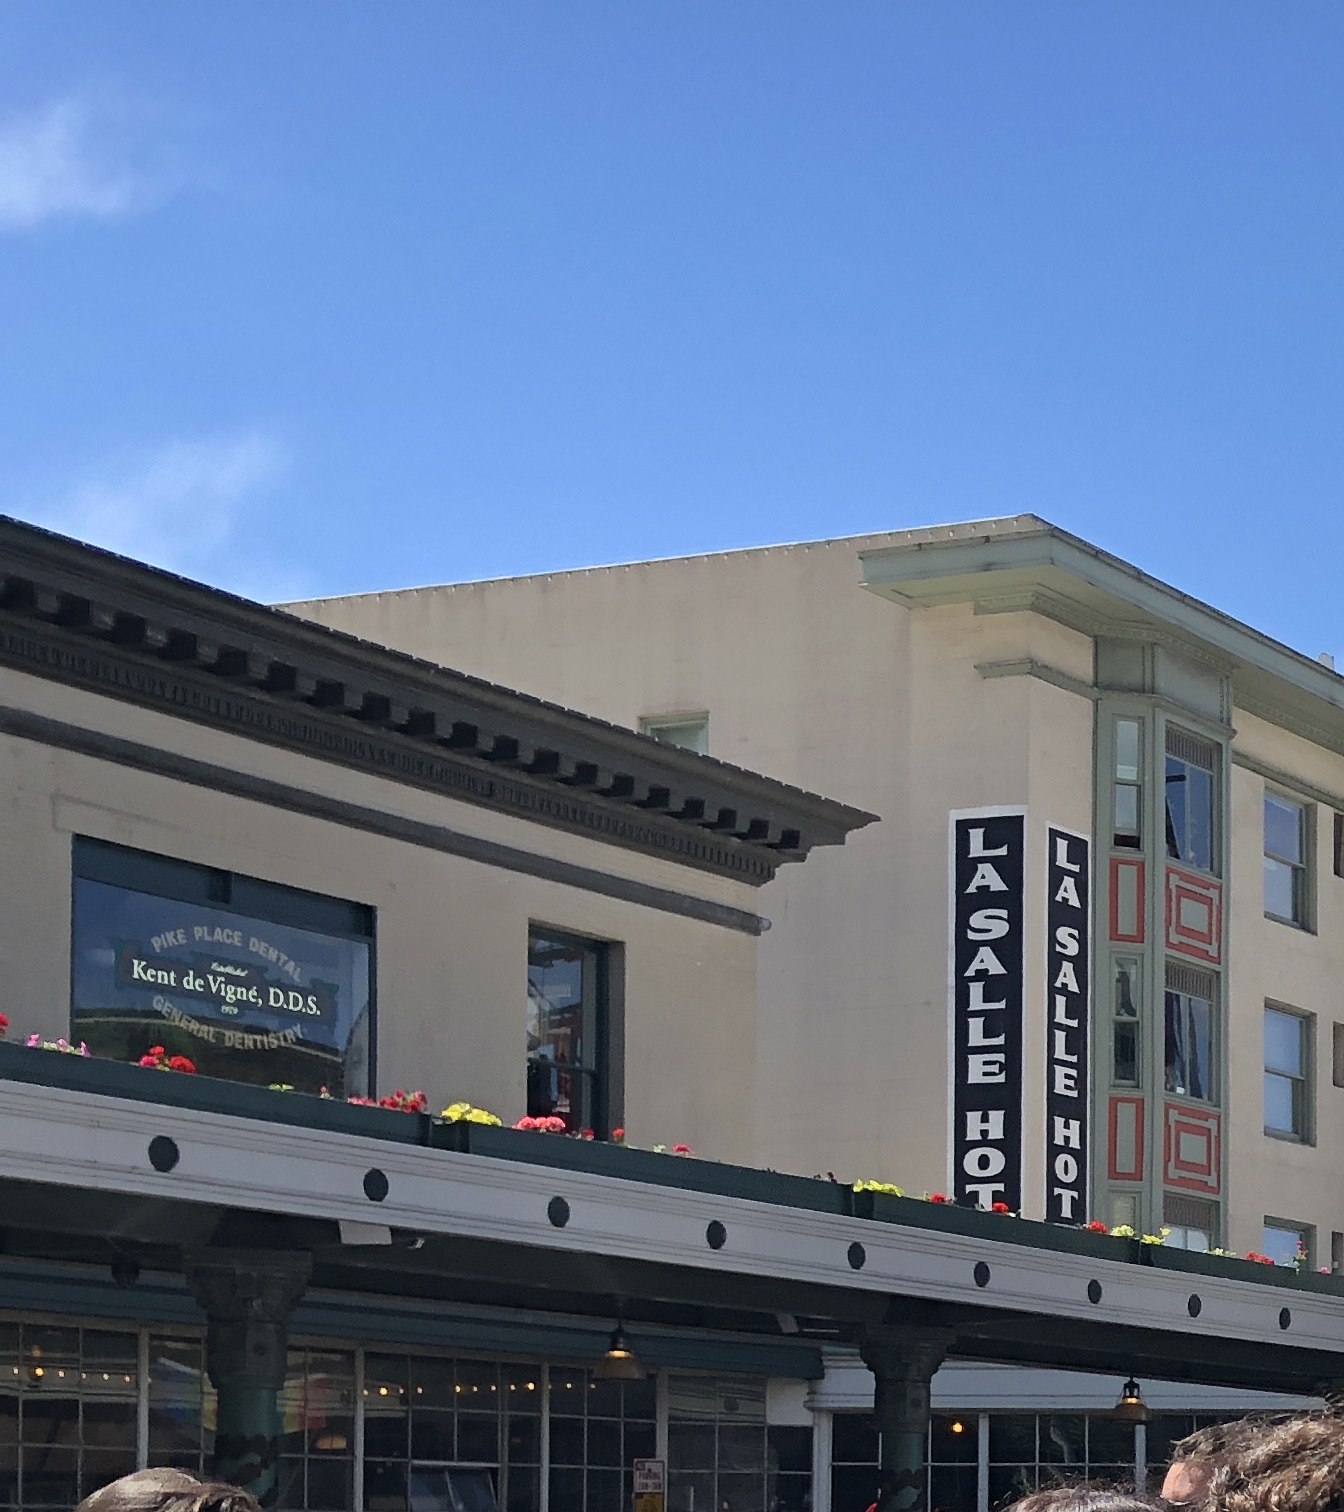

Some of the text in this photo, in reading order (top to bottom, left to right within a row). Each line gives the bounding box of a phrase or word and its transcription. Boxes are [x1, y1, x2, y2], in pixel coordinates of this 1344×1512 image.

[151, 928, 188, 953] PIKE
[194, 926, 243, 947] PLACE
[249, 937, 302, 982] DENTAL
[131, 958, 177, 986] Kent
[183, 970, 205, 991] de
[206, 973, 263, 1007] Vigné,
[268, 986, 321, 1016] D.D.S.
[152, 995, 304, 1050] GENERAL DENTISTRY
[962, 827, 1010, 1211] LA SALLE HOT
[1052, 837, 1082, 1219] LA SALLE HOT
